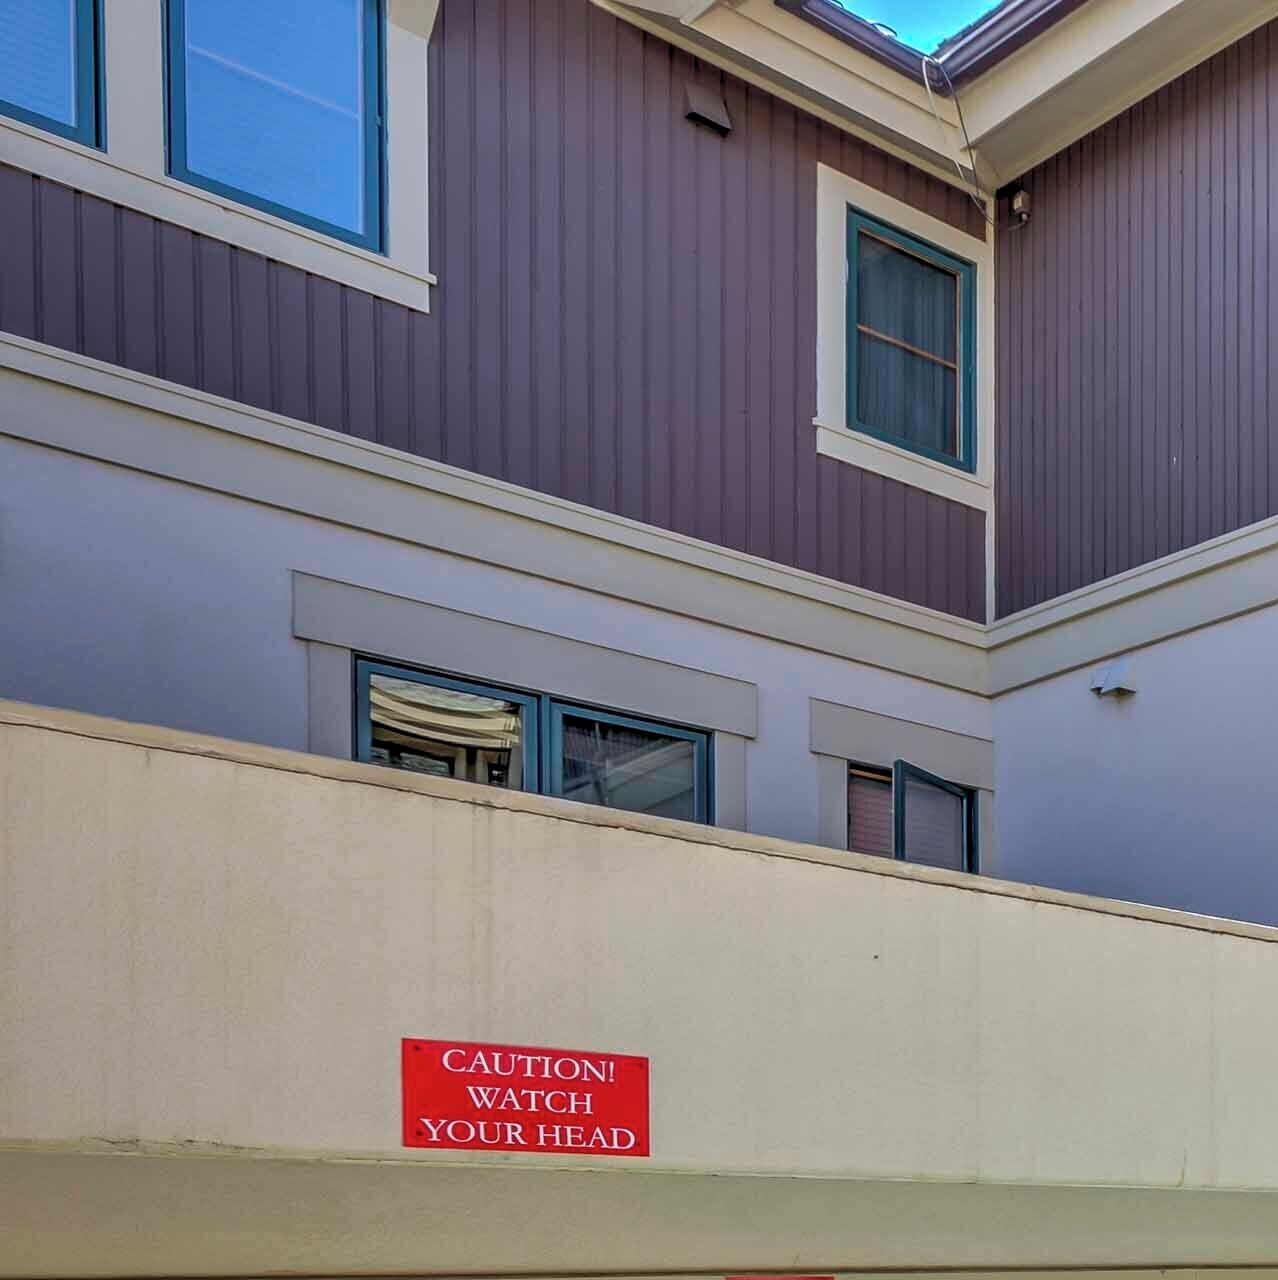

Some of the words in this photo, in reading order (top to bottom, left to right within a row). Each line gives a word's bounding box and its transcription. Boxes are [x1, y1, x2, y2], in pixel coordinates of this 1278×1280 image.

[442, 1049, 615, 1083] CAUTION!
[466, 1086, 594, 1115] WATCH
[420, 1118, 528, 1146] YOUR
[536, 1124, 636, 1150] HEAD
